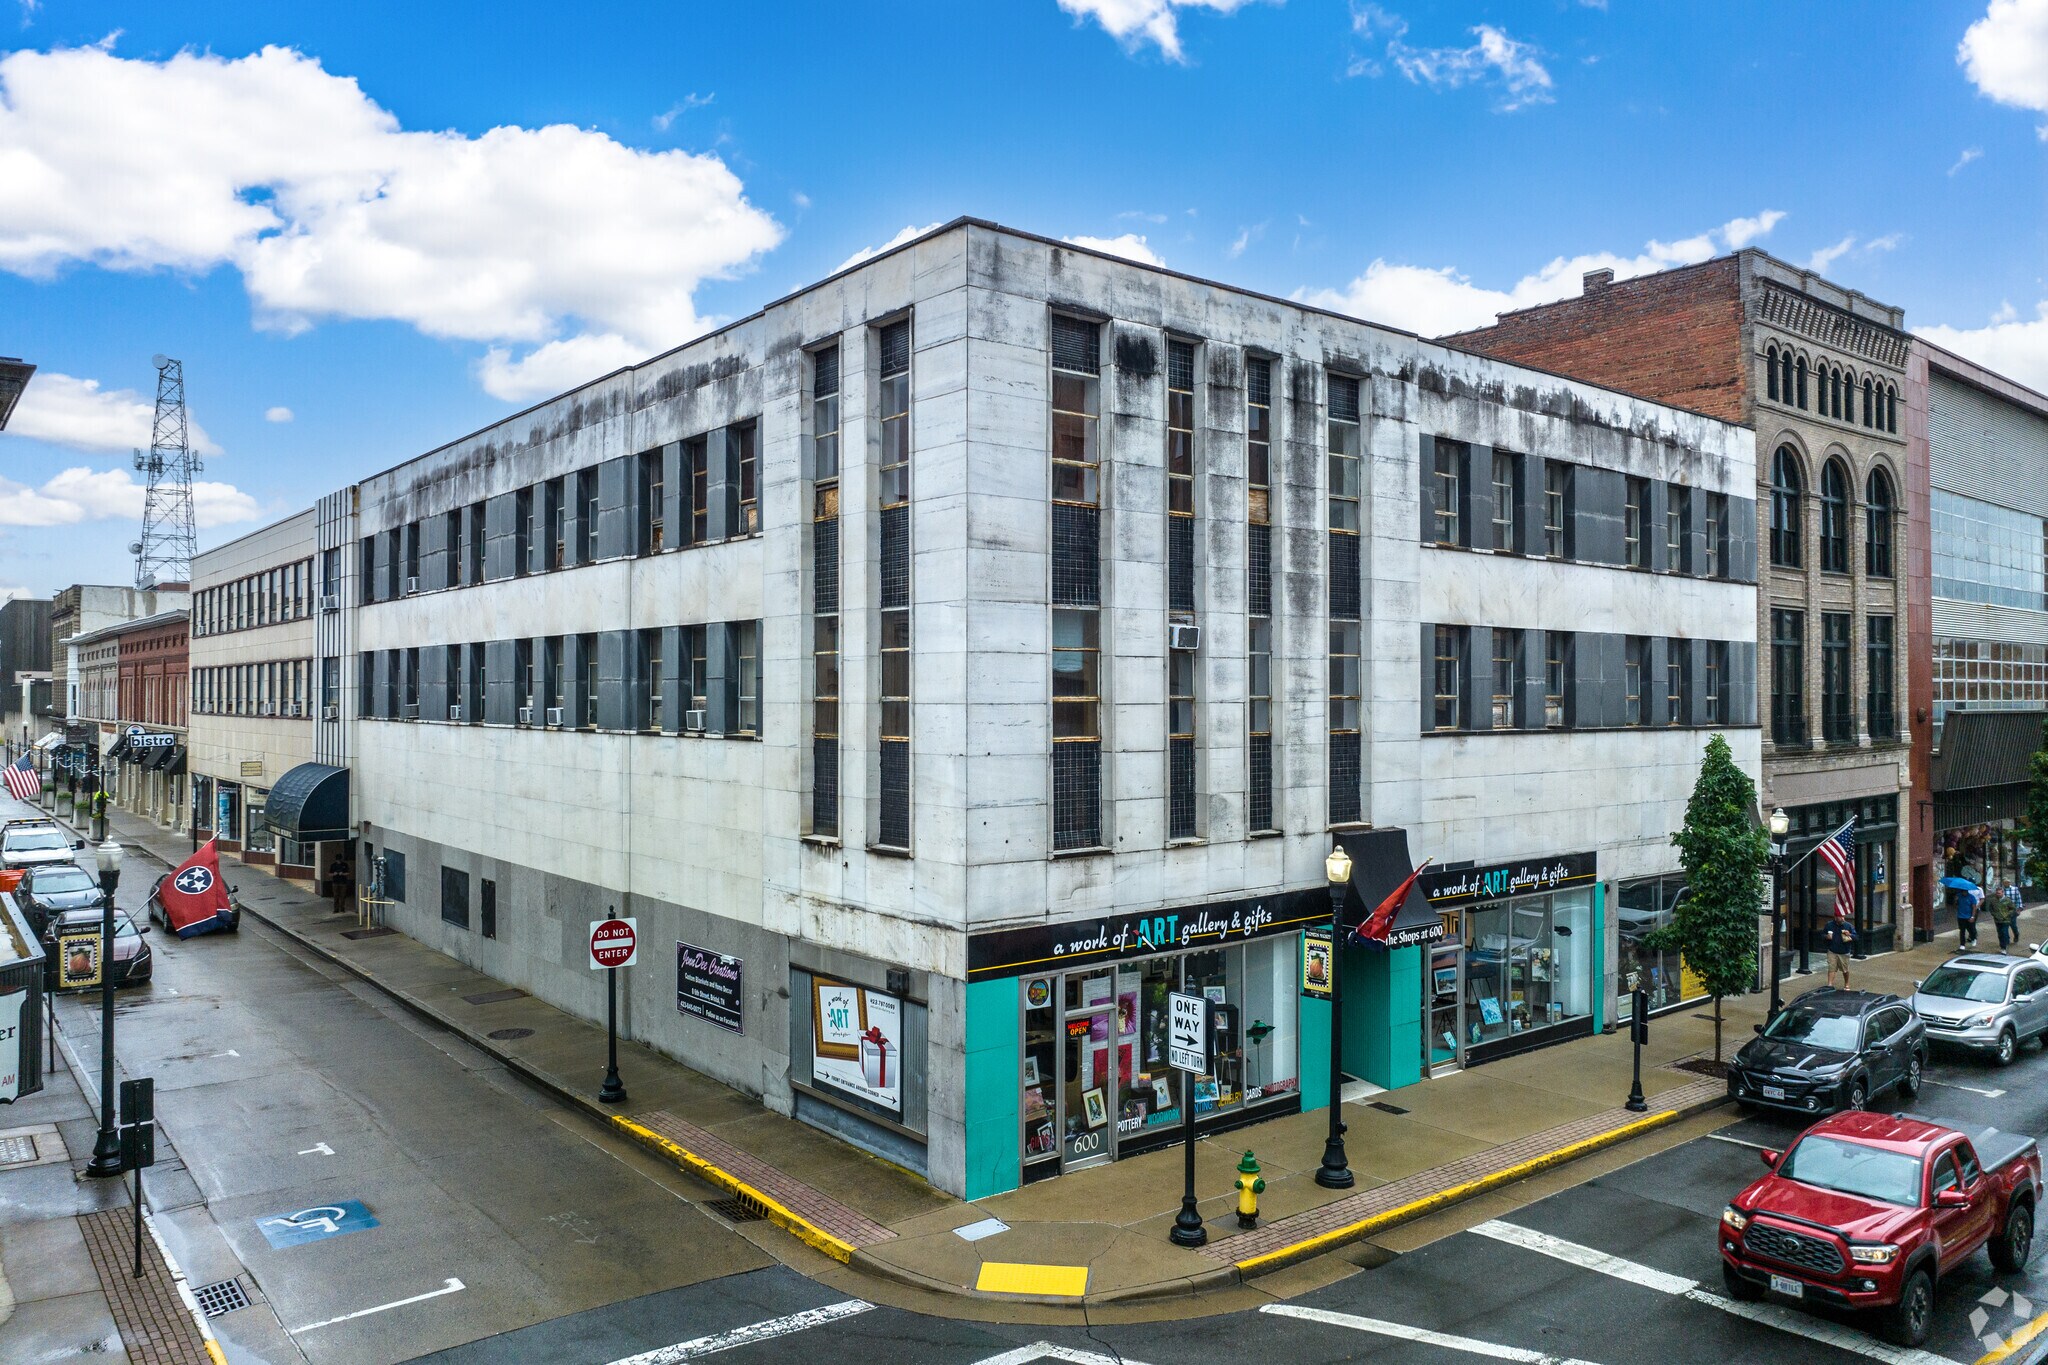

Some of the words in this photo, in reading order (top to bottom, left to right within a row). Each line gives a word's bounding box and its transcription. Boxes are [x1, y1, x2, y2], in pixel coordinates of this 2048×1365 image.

[132, 736, 173, 746] bistro
[1433, 889, 1440, 897] a
[1443, 875, 1467, 895] work
[1470, 875, 1480, 897] of
[1482, 869, 1509, 895] ART
[1510, 867, 1540, 894] gallery
[1541, 867, 1548, 880] &
[1549, 863, 1568, 888] gifts
[597, 930, 609, 939] DO
[612, 927, 630, 937] NOT
[1053, 943, 1064, 955] a
[1070, 925, 1107, 953] work
[1112, 923, 1129, 952] of
[1136, 915, 1178, 949] ART
[1181, 911, 1228, 945] gallery
[1231, 911, 1241, 928] &
[1244, 905, 1272, 936] gifts
[1399, 931, 1420, 944] Shops
[1421, 929, 1428, 939] at
[1429, 925, 1443, 938] 600
[599, 949, 628, 959] ENTER
[708, 957, 738, 981] Creations
[715, 982, 723, 992] Home
[832, 992, 842, 1003] work
[843, 999, 849, 1008] of
[1176, 1000, 1198, 1016] ONE
[724, 1016, 739, 1027] Facebook
[829, 1008, 849, 1029] ART
[1067, 1021, 1089, 1029] WELCOME
[1174, 1016, 1200, 1033] WAY
[1070, 1026, 1087, 1035] OPEN
[1171, 1049, 1178, 1063] NO
[1179, 1051, 1190, 1066] LEFT
[1190, 1054, 1203, 1069] TURN
[1, 1074, 15, 1087] AM
[841, 1079, 855, 1089] ENTRANCE
[855, 1084, 867, 1093] AROUND
[867, 1089, 879, 1098] CORNER
[1264, 1077, 1297, 1095] PHOTOGRAPHY
[1218, 1090, 1243, 1108] JEWELRY
[1246, 1086, 1262, 1100] CARDS
[1117, 1116, 1142, 1132] POTTERY
[1147, 1107, 1180, 1126] WOODWORK
[1030, 1133, 1050, 1149] GIFTS
[1074, 1132, 1099, 1153] 600
